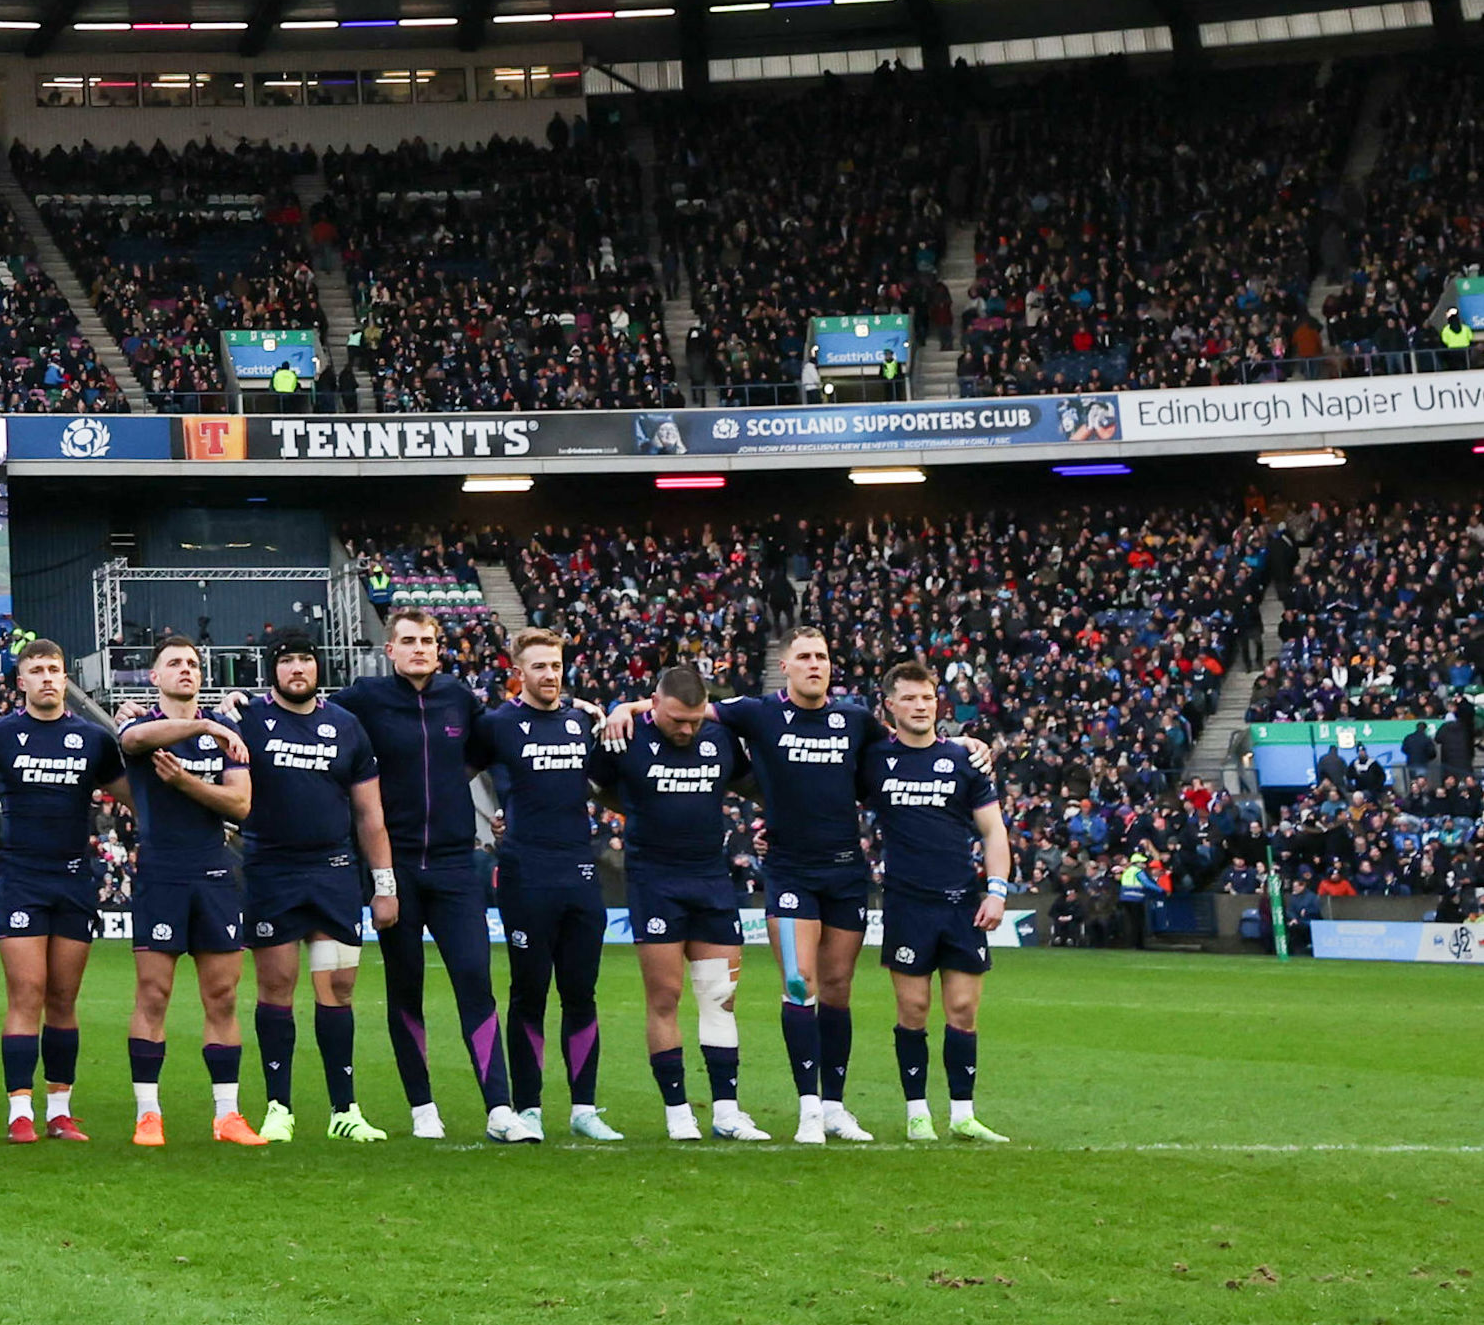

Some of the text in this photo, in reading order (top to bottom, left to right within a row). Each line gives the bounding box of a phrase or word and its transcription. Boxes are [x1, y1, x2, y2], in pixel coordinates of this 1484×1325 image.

[1138, 381, 1484, 427] Edinburgh Napier Univ
[746, 408, 1031, 437] SCOTLAND SUPPORTERS CLUB
[199, 422, 229, 455] T
[758, 445, 779, 453] NOW
[780, 444, 797, 452] FOR
[264, 738, 338, 758] Arnold
[521, 742, 587, 757] Arnold
[777, 733, 849, 750] Arnold
[13, 754, 87, 771] Arnold
[178, 756, 223, 772] nold
[273, 752, 331, 771] Clark
[532, 755, 584, 771] Clark
[787, 748, 844, 764] Clark
[21, 768, 80, 785] Clark
[647, 764, 720, 780] Arnold
[656, 777, 713, 793] Clark
[881, 778, 956, 795] Arnold
[890, 791, 948, 807] Clark
